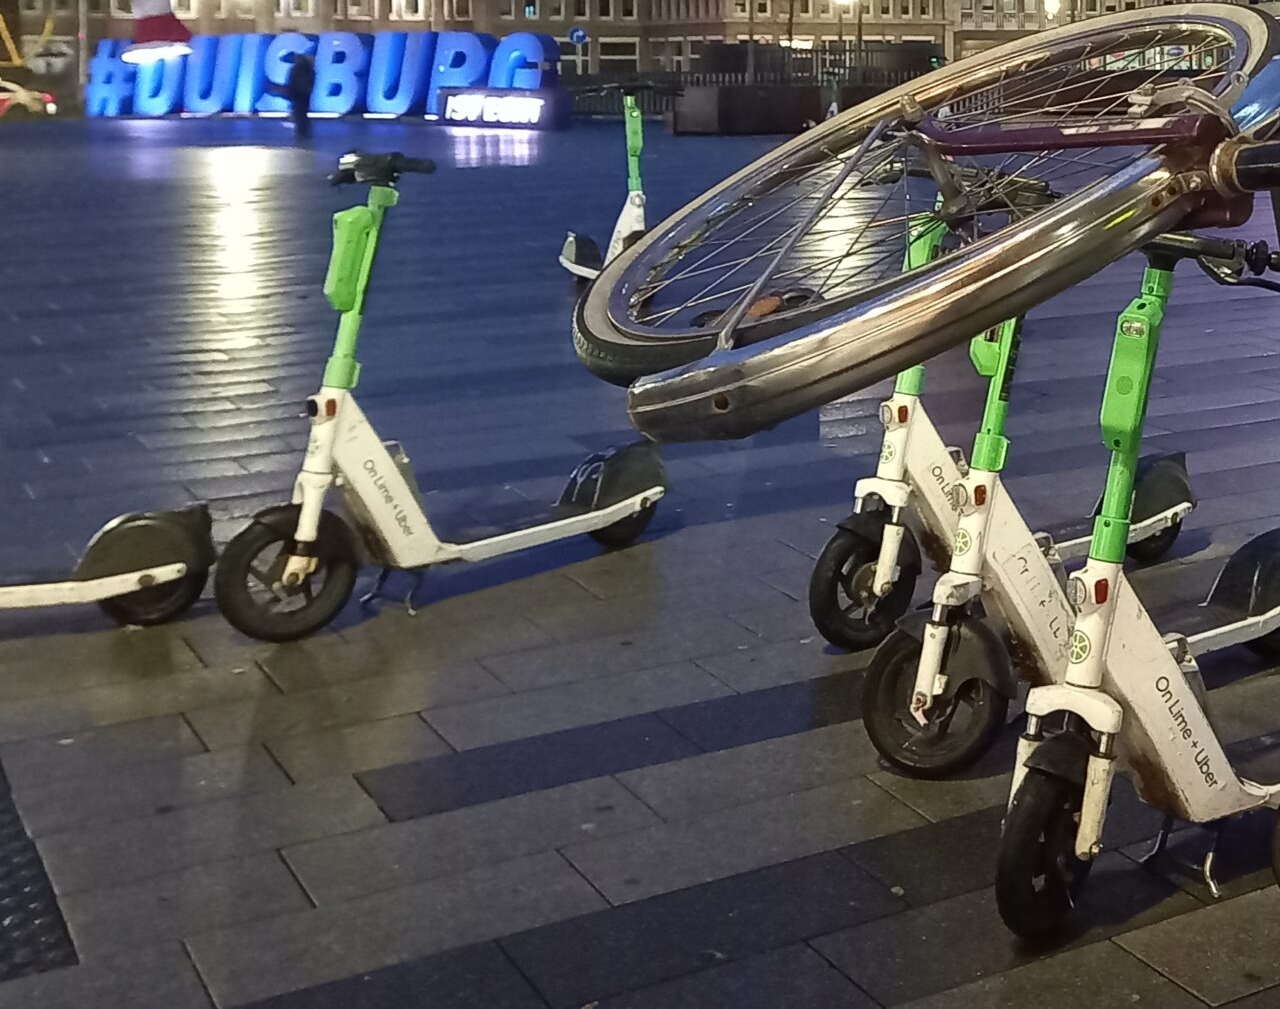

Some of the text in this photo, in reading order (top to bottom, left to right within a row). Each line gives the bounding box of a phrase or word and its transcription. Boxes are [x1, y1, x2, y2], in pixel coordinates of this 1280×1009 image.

[86, 31, 546, 118] #DUISBURG
[362, 458, 379, 479] On
[931, 465, 945, 486] On
[1155, 675, 1219, 788] On Lime + Uber
